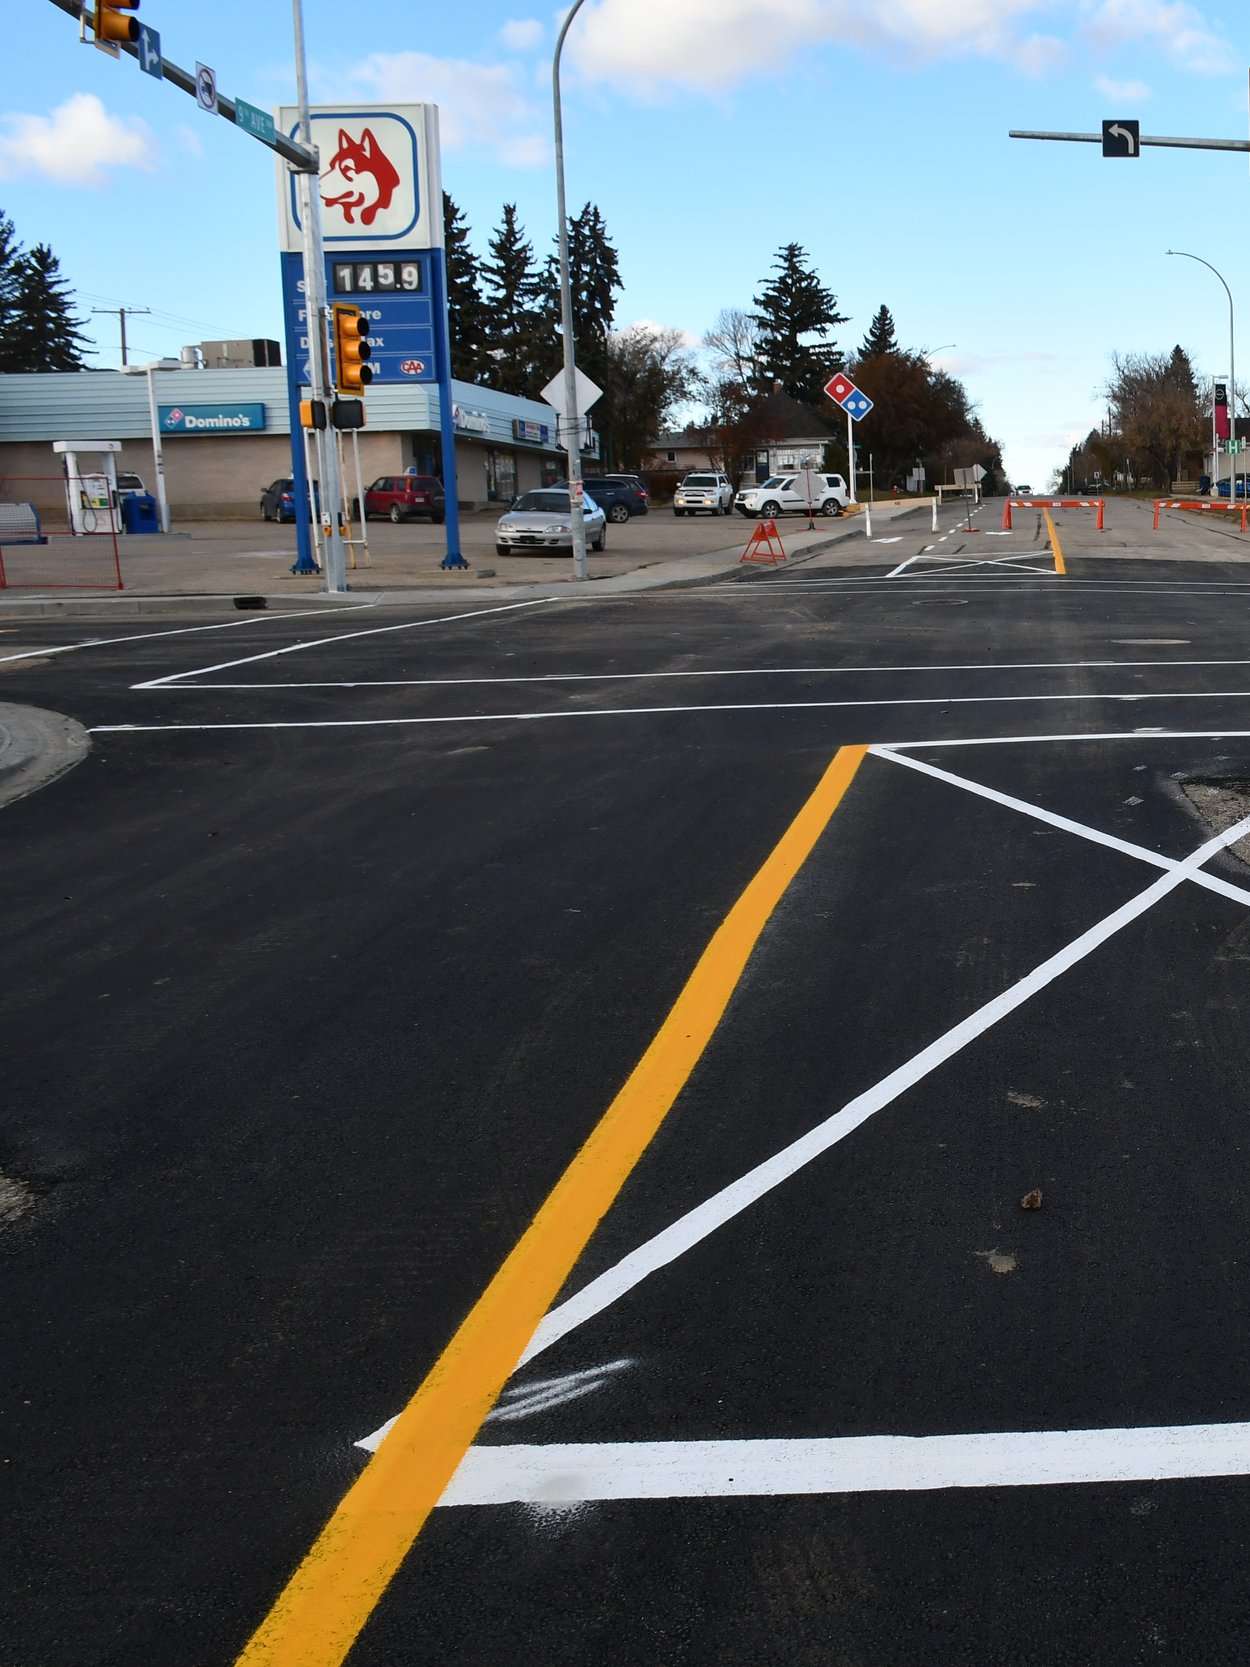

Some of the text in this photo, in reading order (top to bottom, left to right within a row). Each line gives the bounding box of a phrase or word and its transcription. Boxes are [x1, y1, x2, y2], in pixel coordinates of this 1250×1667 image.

[402, 360, 423, 374] CAA
[184, 413, 251, 429] Domino's
[1229, 441, 1238, 454] H
